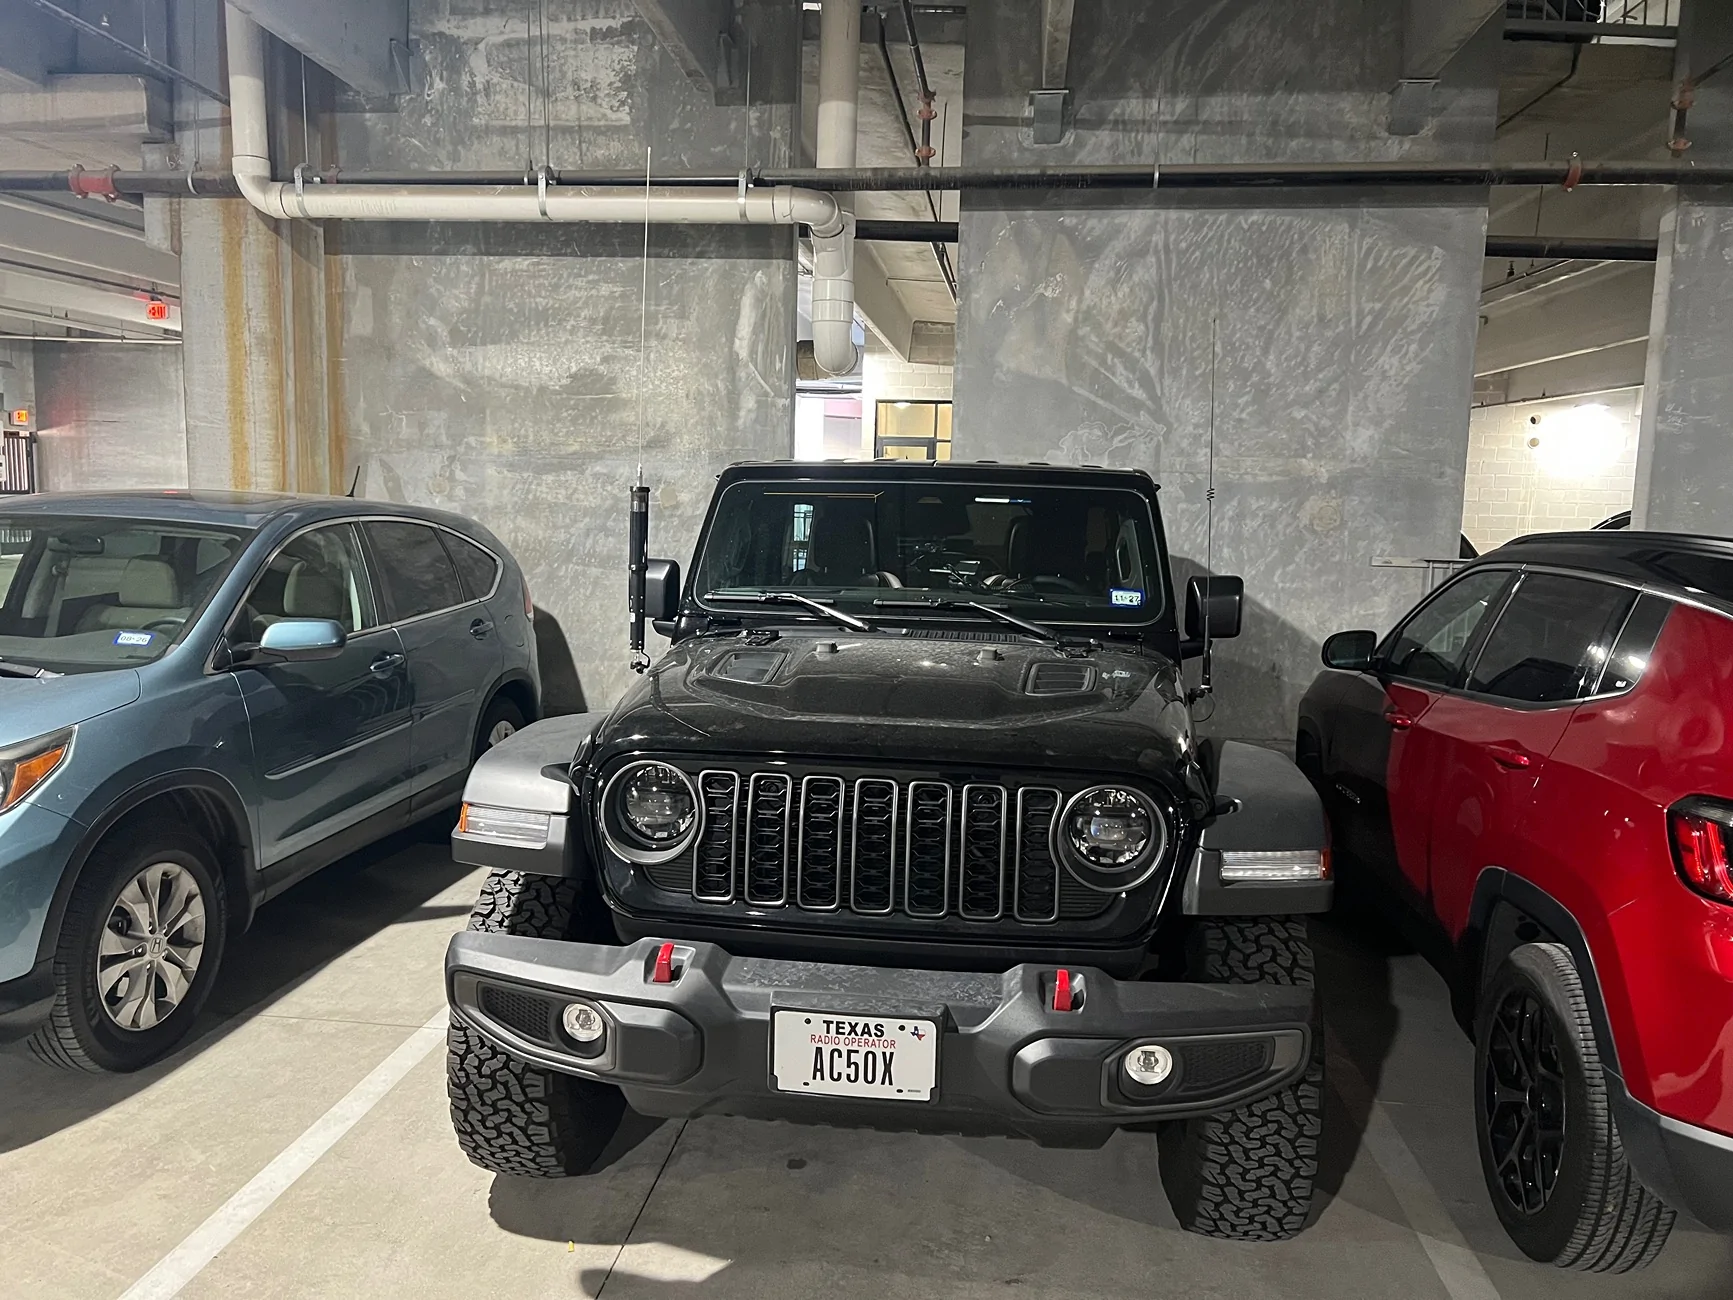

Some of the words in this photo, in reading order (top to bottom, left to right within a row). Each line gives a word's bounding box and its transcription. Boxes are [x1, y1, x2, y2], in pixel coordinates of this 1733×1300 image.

[822, 1019, 885, 1038] TEXAS
[810, 1034, 841, 1046] RADIO
[843, 1036, 896, 1049] OPERATOR
